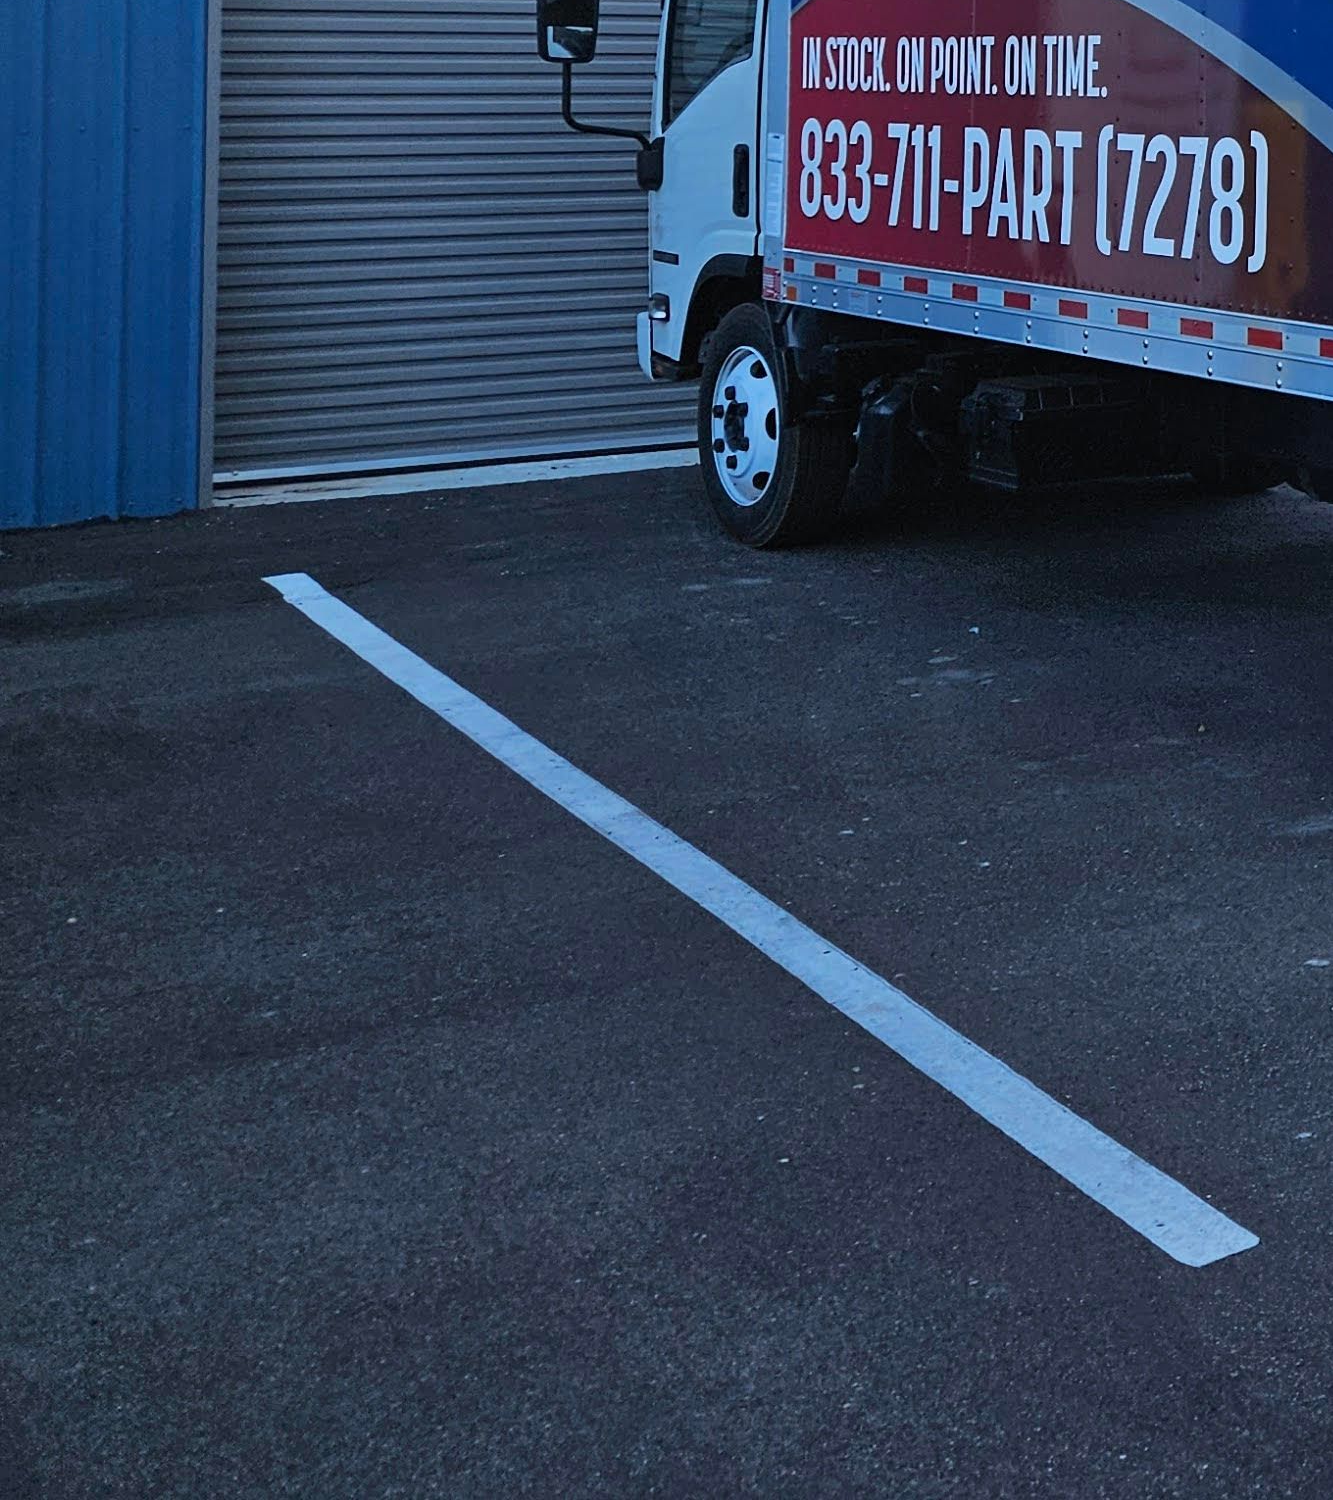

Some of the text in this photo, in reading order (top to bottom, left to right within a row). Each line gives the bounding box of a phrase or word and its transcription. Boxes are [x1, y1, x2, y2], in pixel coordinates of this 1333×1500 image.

[802, 34, 1108, 98] IN STOCK. ON POINT. ON TIME.
[799, 117, 1083, 246] 833-711-PART
[1096, 124, 1270, 273] (7278)
